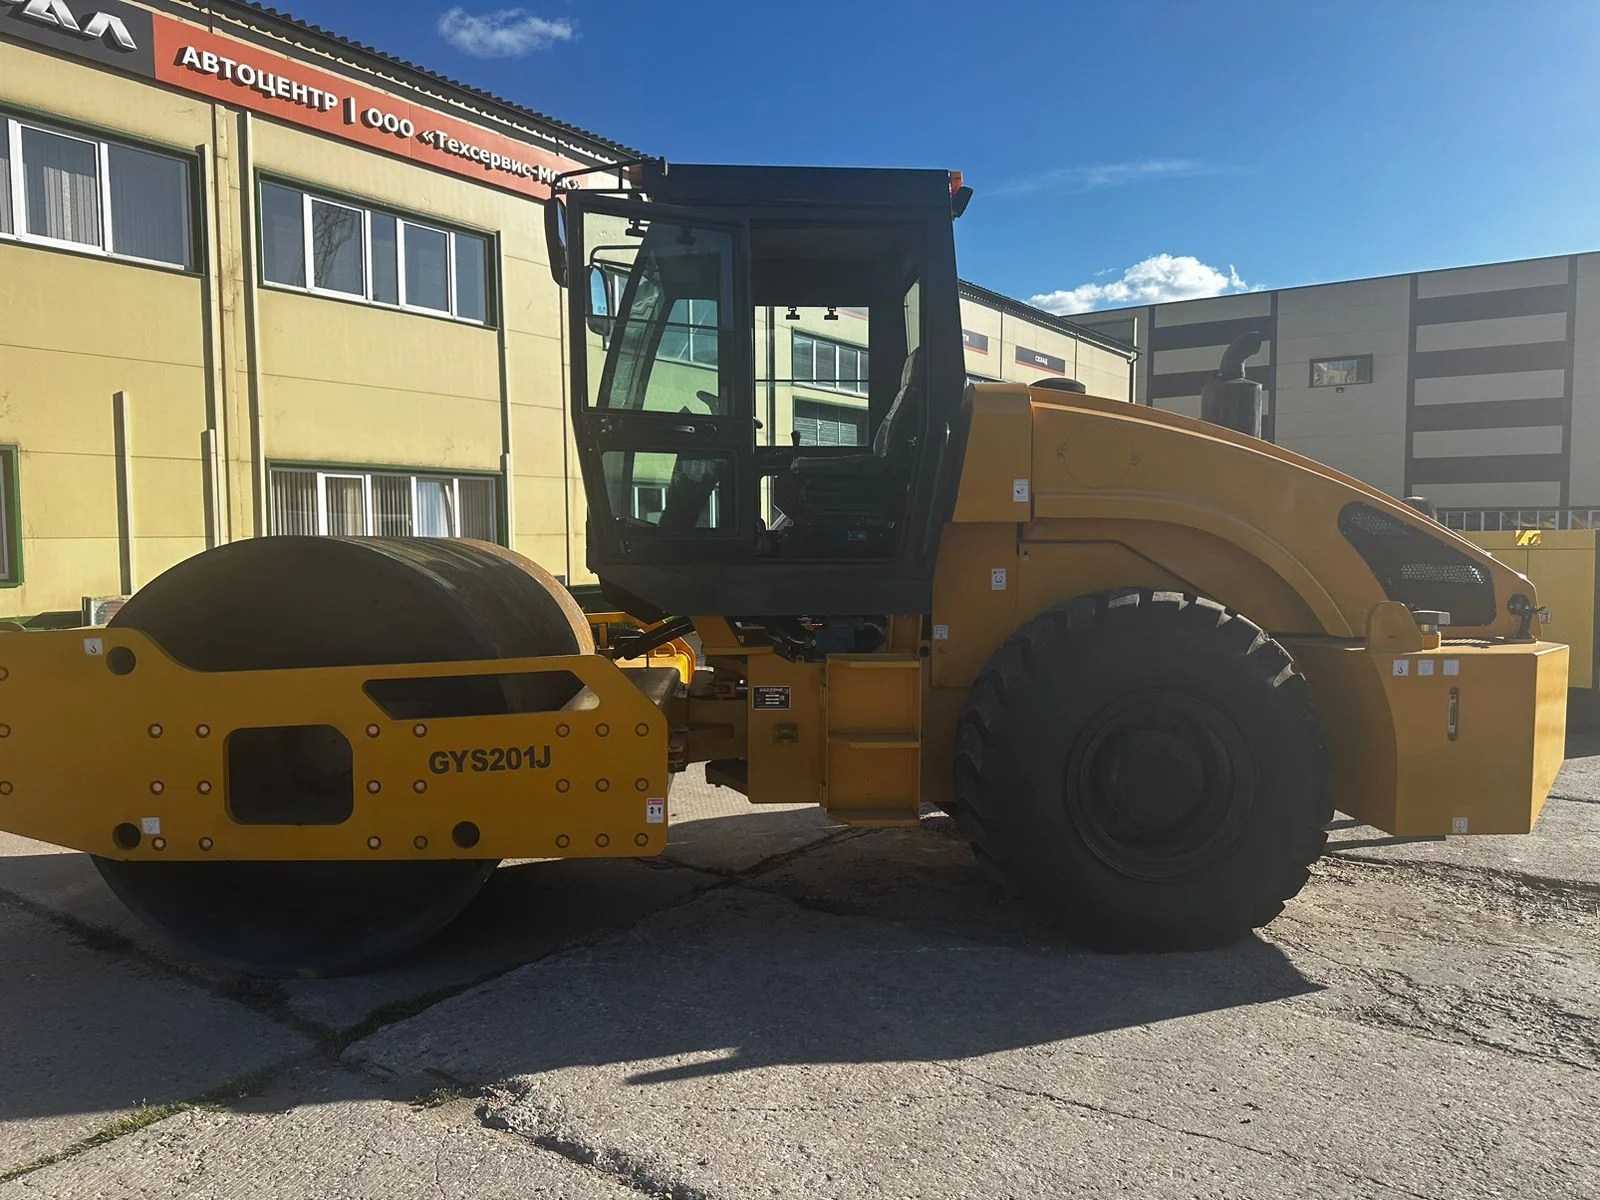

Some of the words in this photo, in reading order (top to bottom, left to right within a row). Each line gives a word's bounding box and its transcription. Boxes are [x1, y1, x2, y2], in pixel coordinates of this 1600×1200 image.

[9, 0, 138, 50] АЛ
[181, 45, 338, 111] АВТОЦЕНТР
[367, 108, 415, 138] ООО
[428, 745, 552, 774] GYS201J
